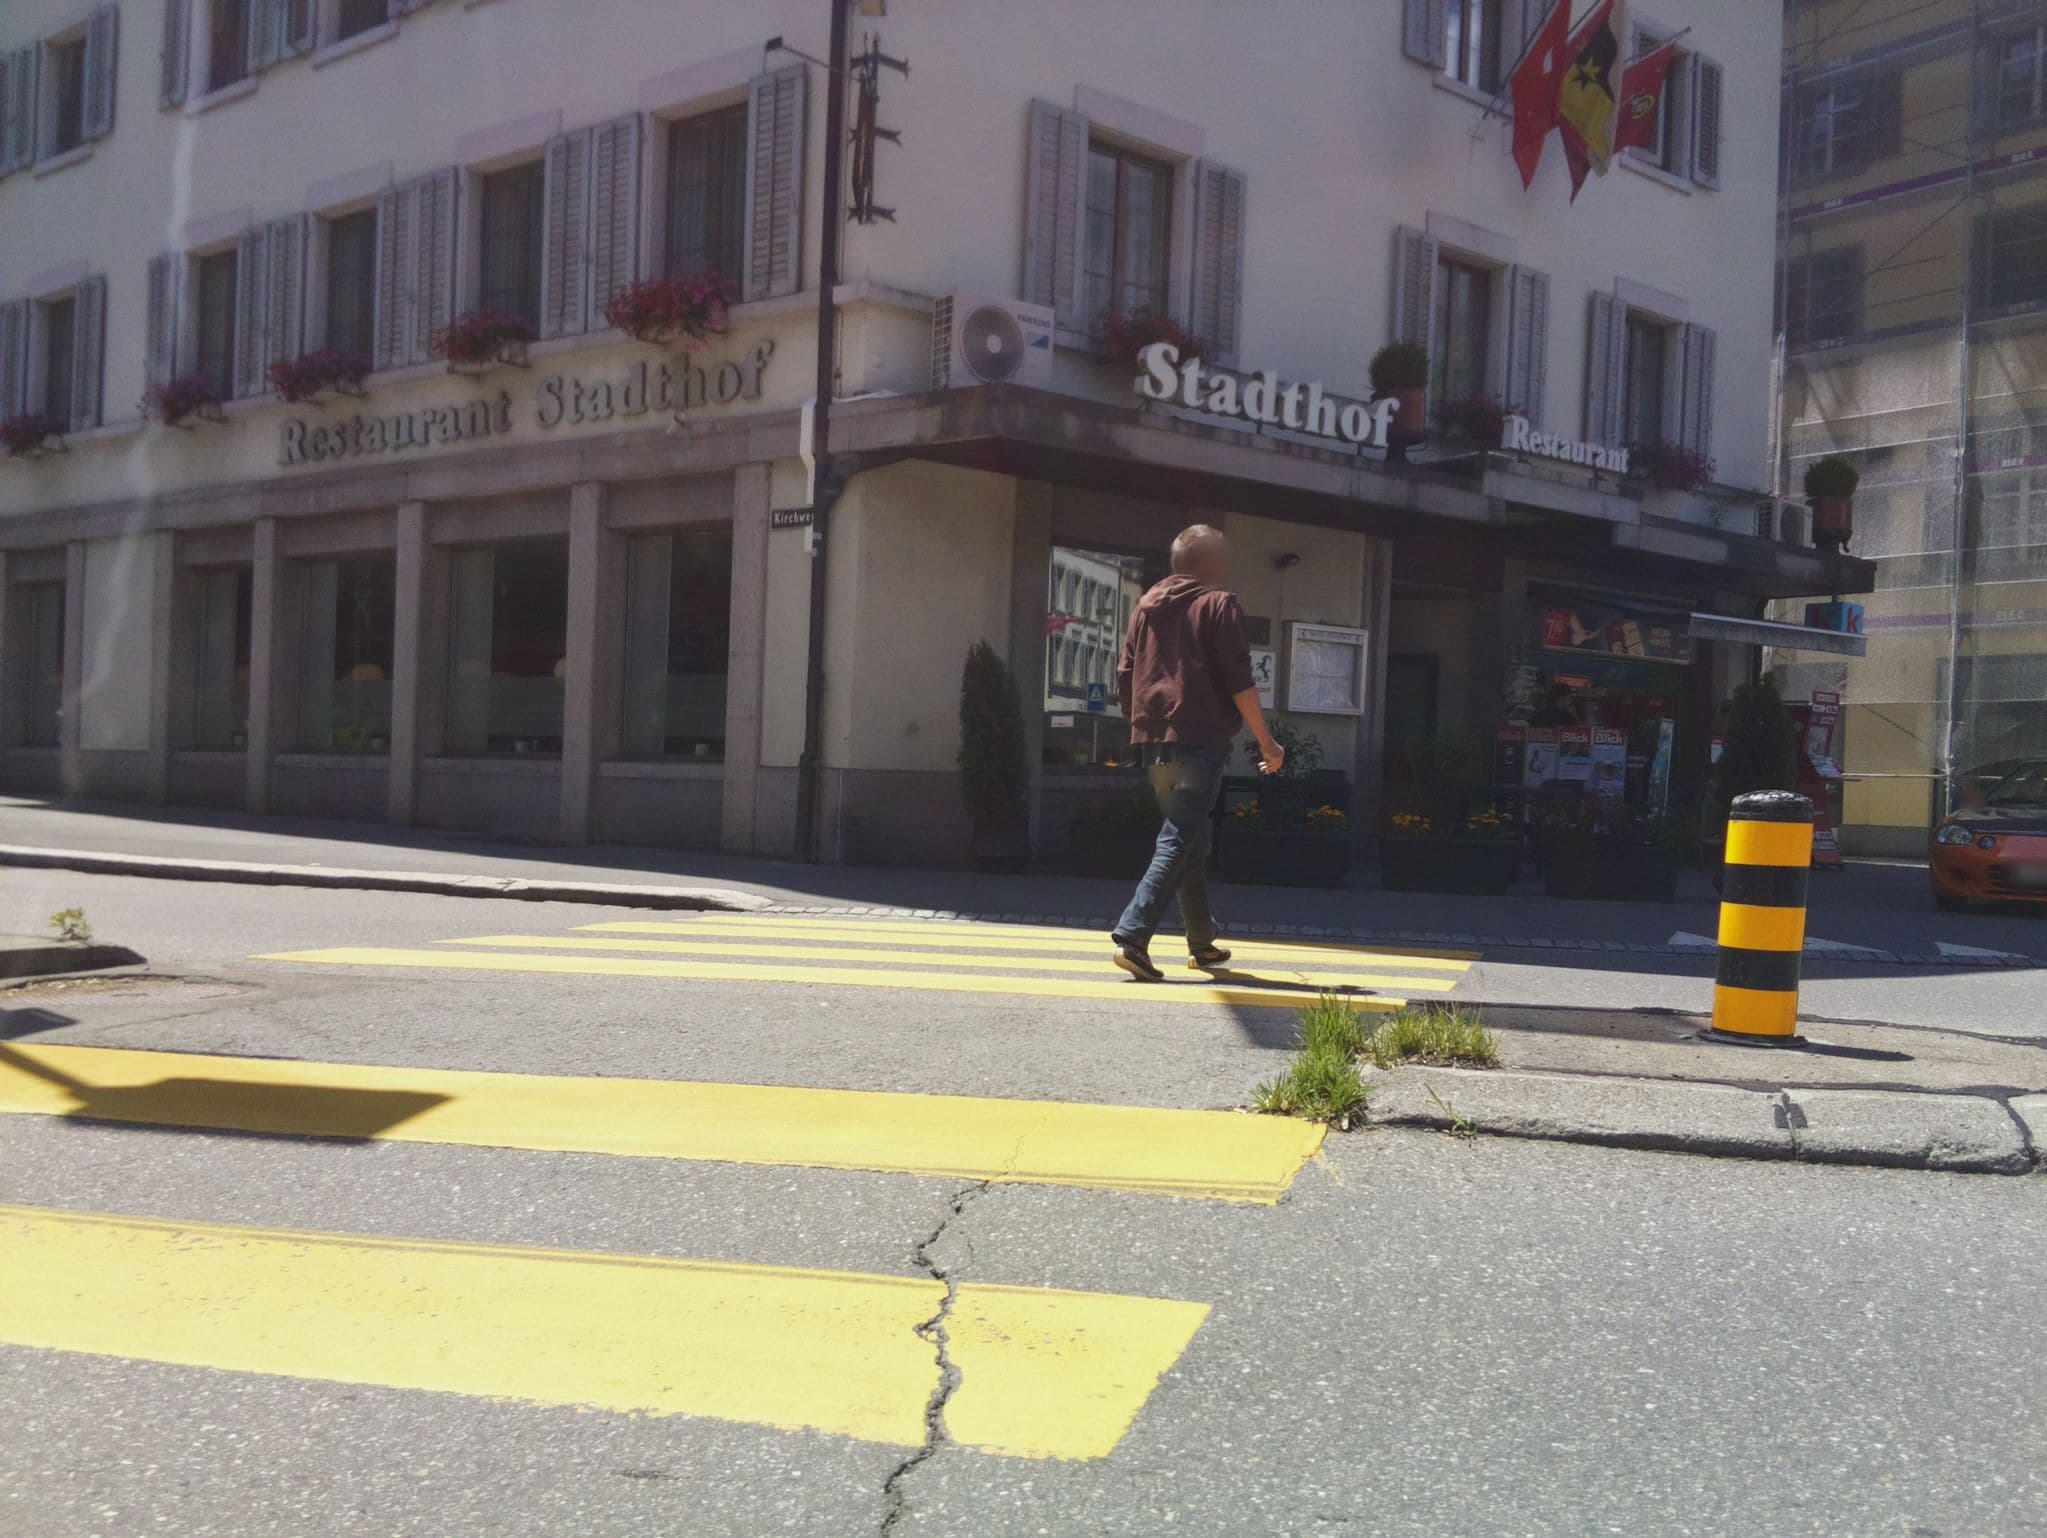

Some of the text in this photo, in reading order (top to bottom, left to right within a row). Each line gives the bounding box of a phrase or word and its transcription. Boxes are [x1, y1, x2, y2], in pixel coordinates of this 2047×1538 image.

[280, 339, 776, 465] Restaurant Stadthof
[1137, 341, 1400, 448] Stadthof
[1505, 415, 1631, 474] Restaurant
[1561, 732, 1589, 743] Blick
[1594, 732, 1624, 744] Blick
